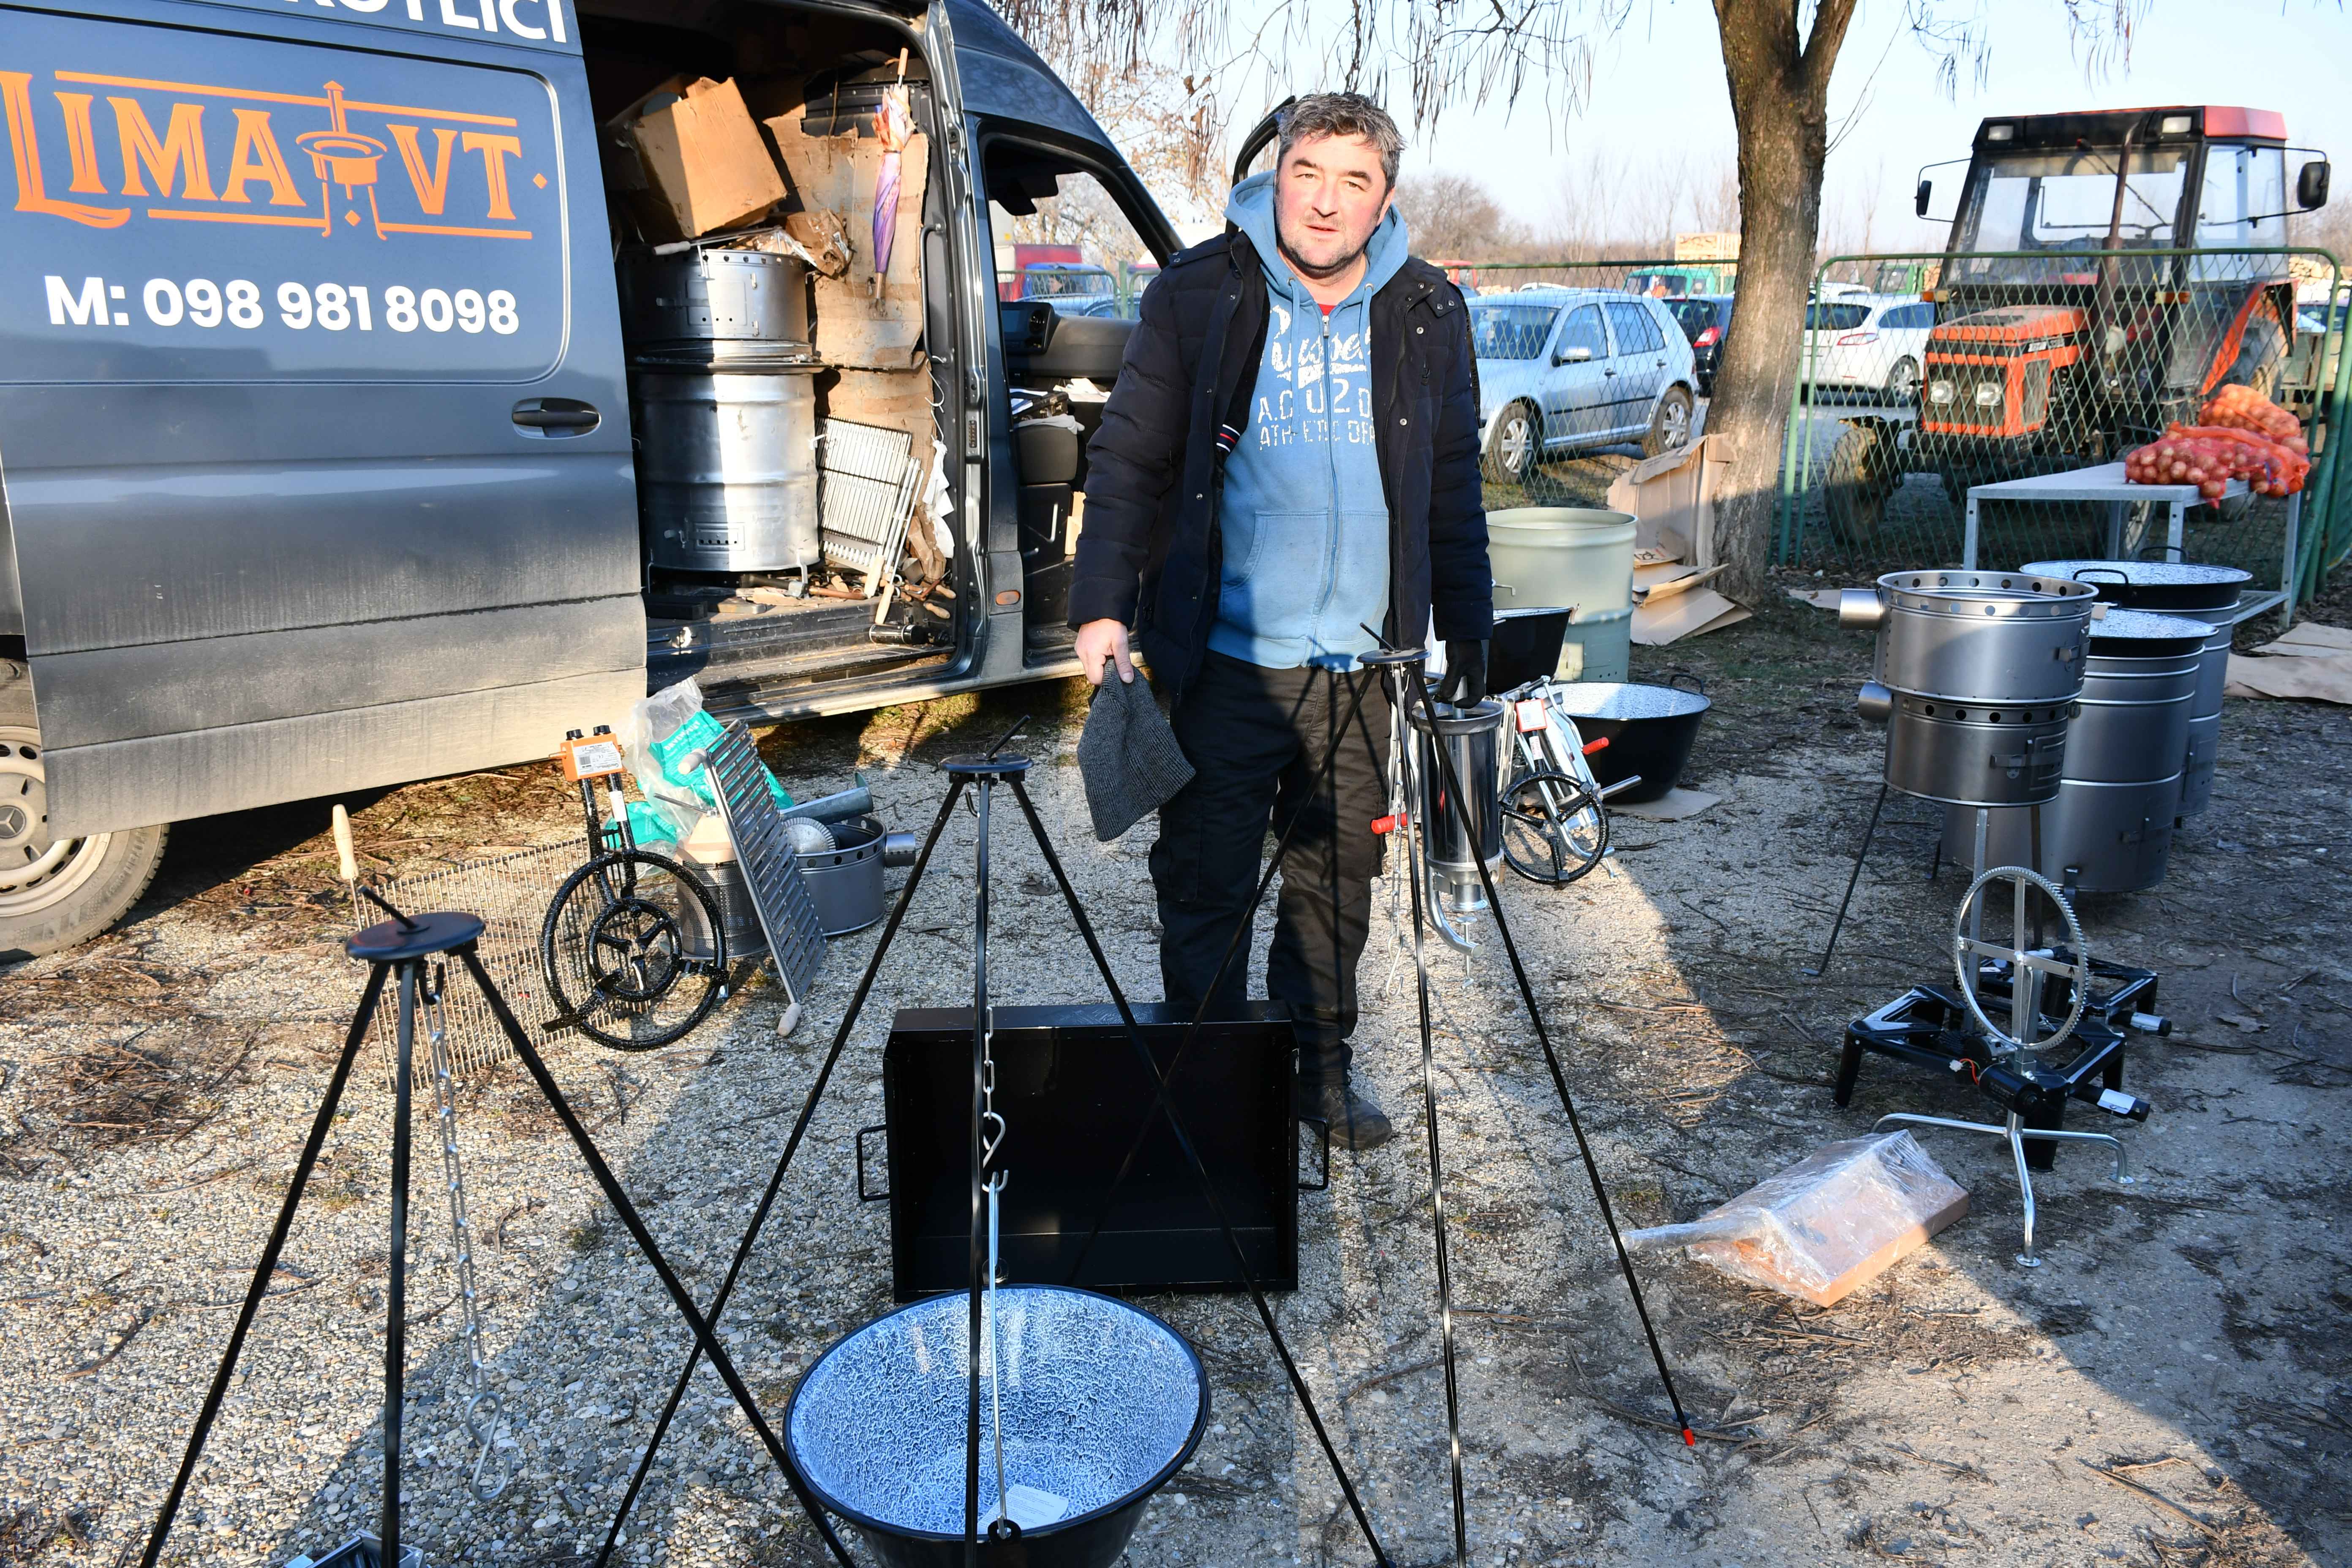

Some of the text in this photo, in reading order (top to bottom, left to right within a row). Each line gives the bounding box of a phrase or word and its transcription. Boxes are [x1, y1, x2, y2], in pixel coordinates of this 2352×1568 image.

[284, 0, 566, 42] LICI
[0, 71, 521, 229] LIMA VT
[45, 275, 519, 335] M: 098 981 8098
